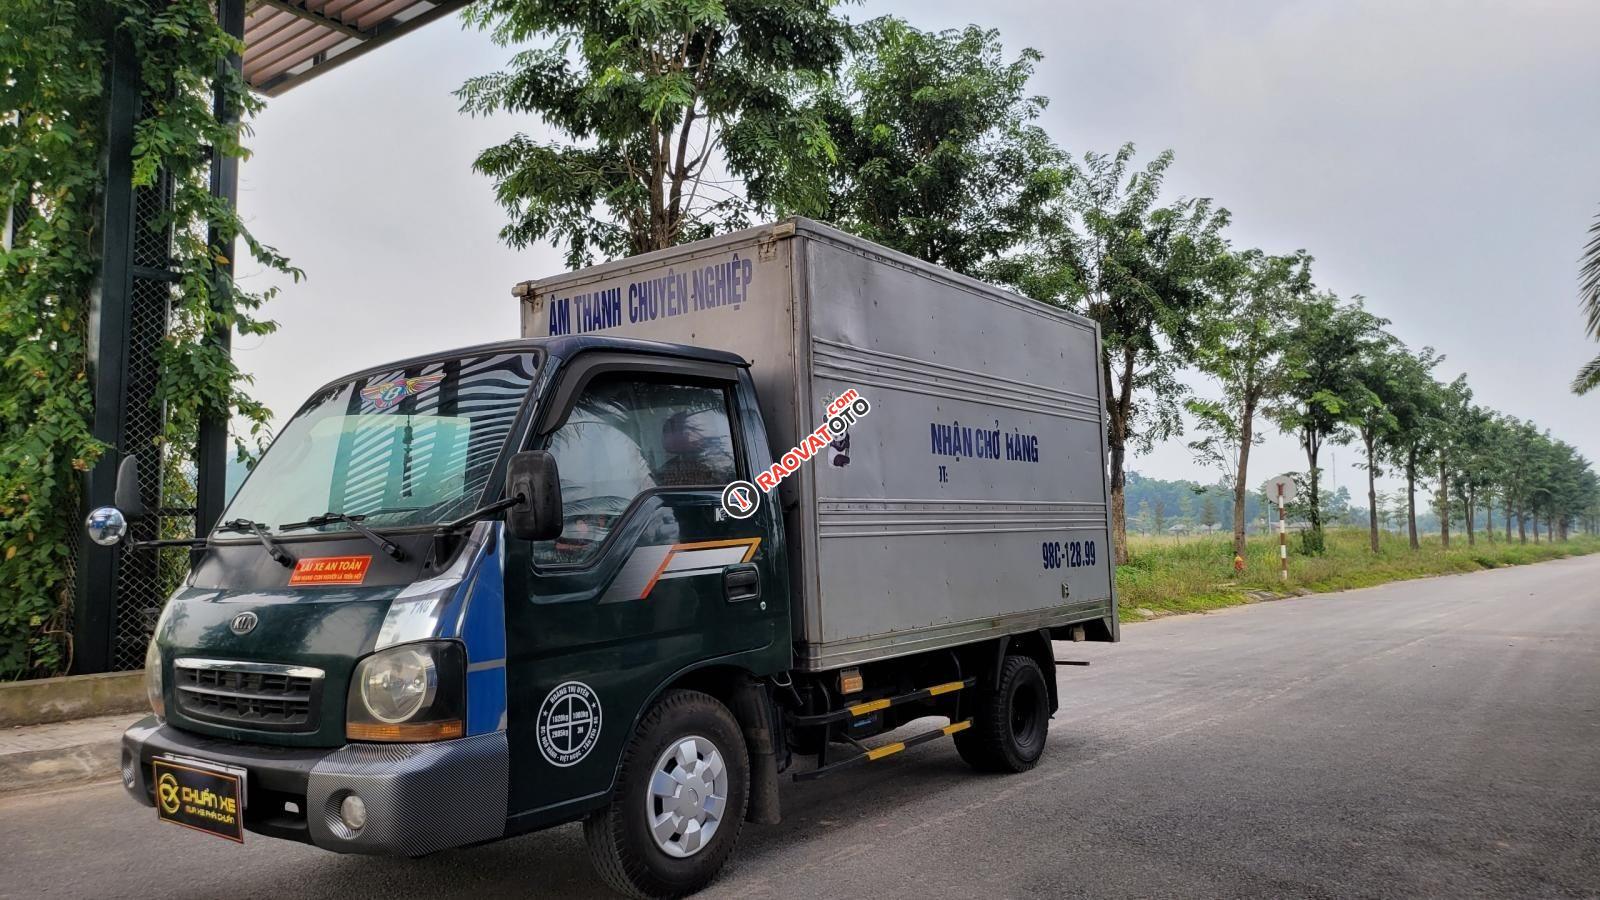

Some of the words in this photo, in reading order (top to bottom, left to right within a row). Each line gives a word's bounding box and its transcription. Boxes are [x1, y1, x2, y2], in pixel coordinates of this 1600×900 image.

[549, 294, 571, 336] ÂM
[574, 287, 622, 334] THANH
[628, 268, 688, 323] CHUYÊN
[692, 252, 753, 311] NGHIỆP
[930, 421, 973, 462] NHẬN
[975, 419, 1001, 460] CHỞ
[1005, 427, 1039, 463] HÀNG
[1042, 541, 1096, 569] 98C-128.99
[313, 562, 325, 572] XE
[324, 562, 338, 571] AN
[233, 616, 253, 629] KIA
[219, 795, 236, 813] XE
